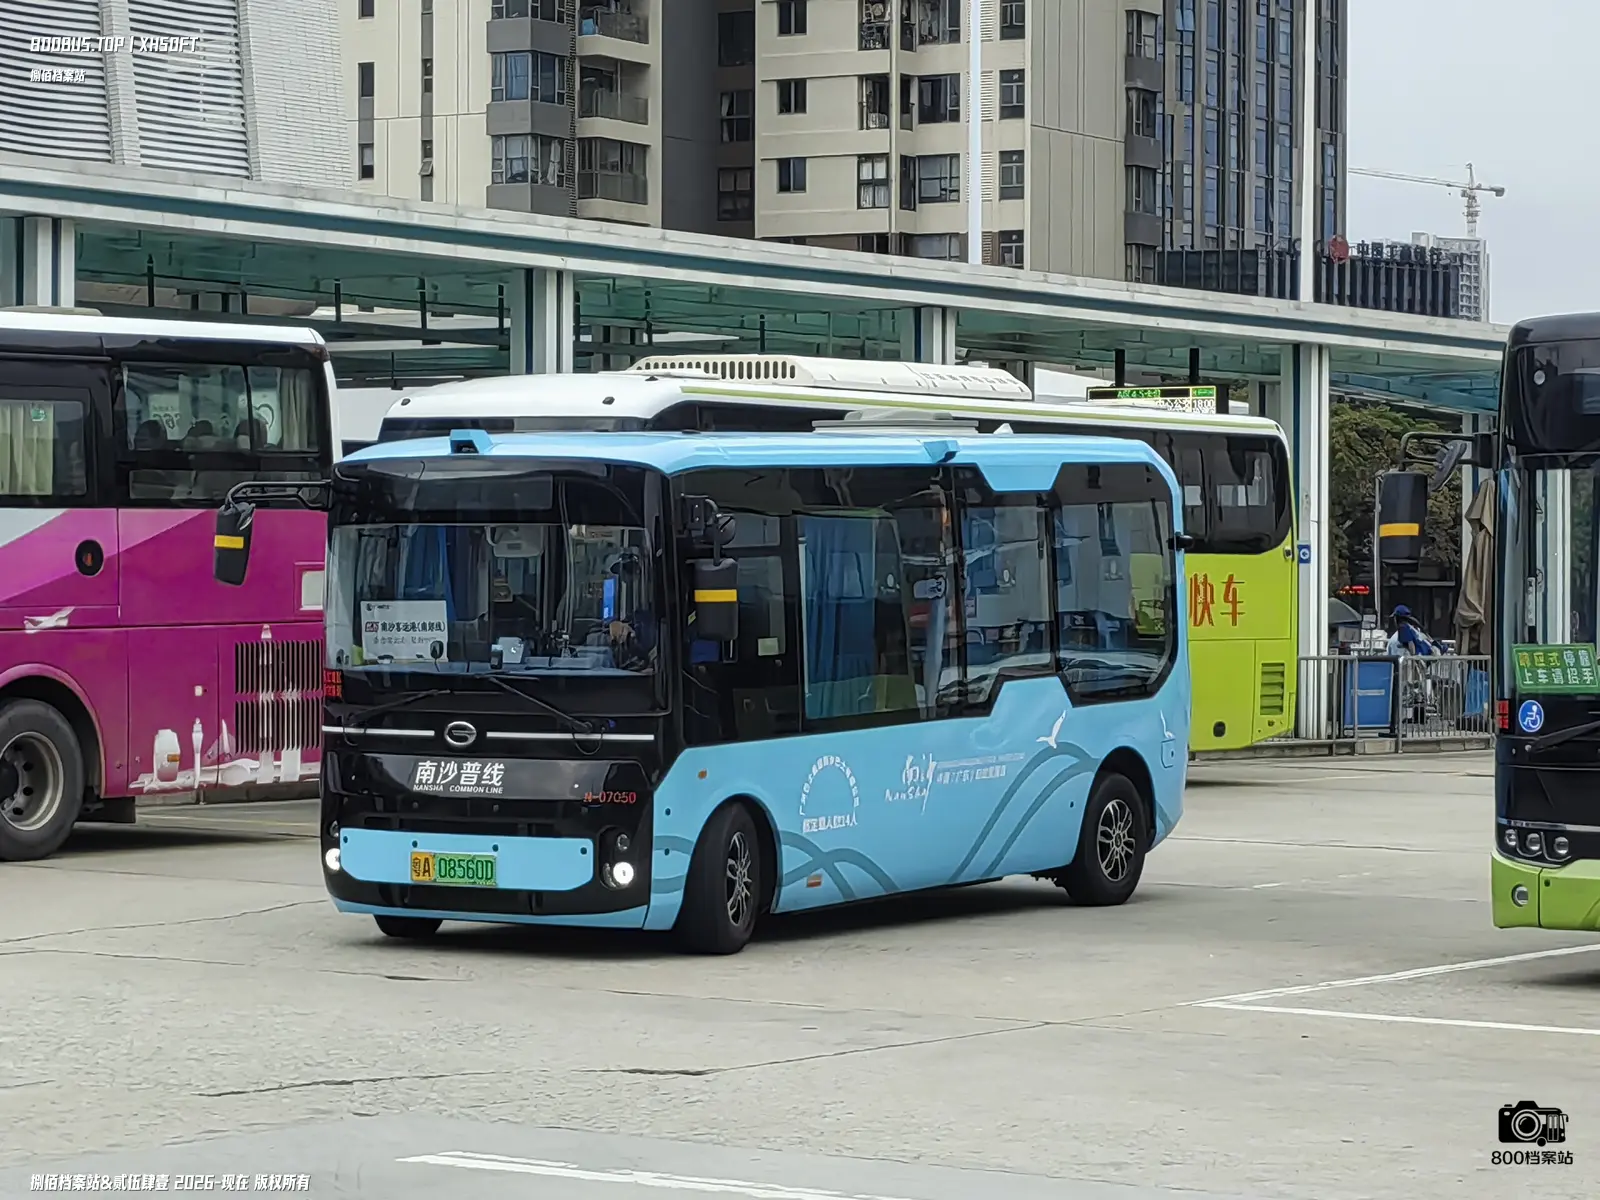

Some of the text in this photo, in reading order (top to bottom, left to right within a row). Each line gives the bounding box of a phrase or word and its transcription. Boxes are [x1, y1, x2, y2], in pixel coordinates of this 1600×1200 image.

[415, 760, 505, 786] 南沙普线
[413, 784, 504, 794] NANSHA COMMON LINE
